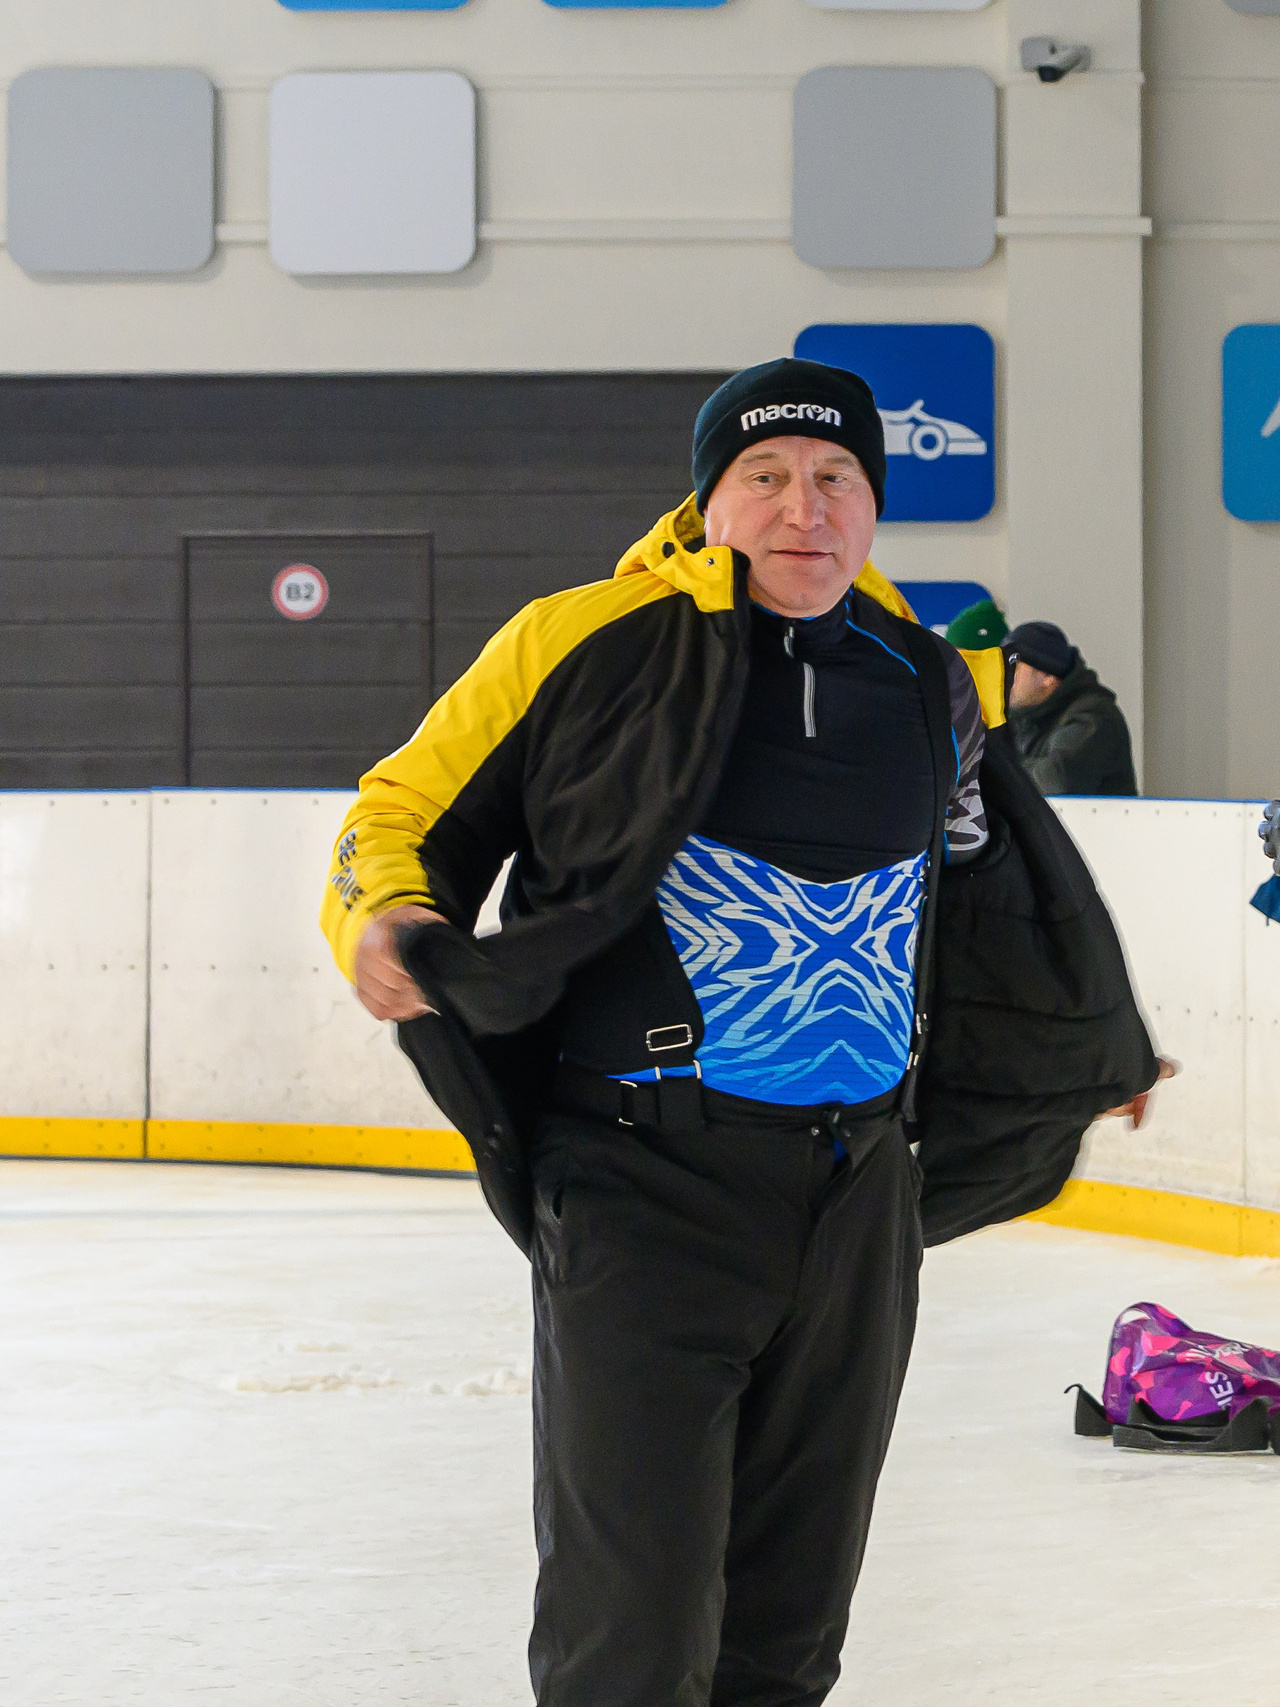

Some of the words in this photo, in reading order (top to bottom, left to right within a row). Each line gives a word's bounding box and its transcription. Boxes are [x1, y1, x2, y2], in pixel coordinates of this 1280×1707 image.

[741, 403, 841, 431] macron
[286, 582, 315, 601] B2
[1204, 1371, 1234, 1411] IES
